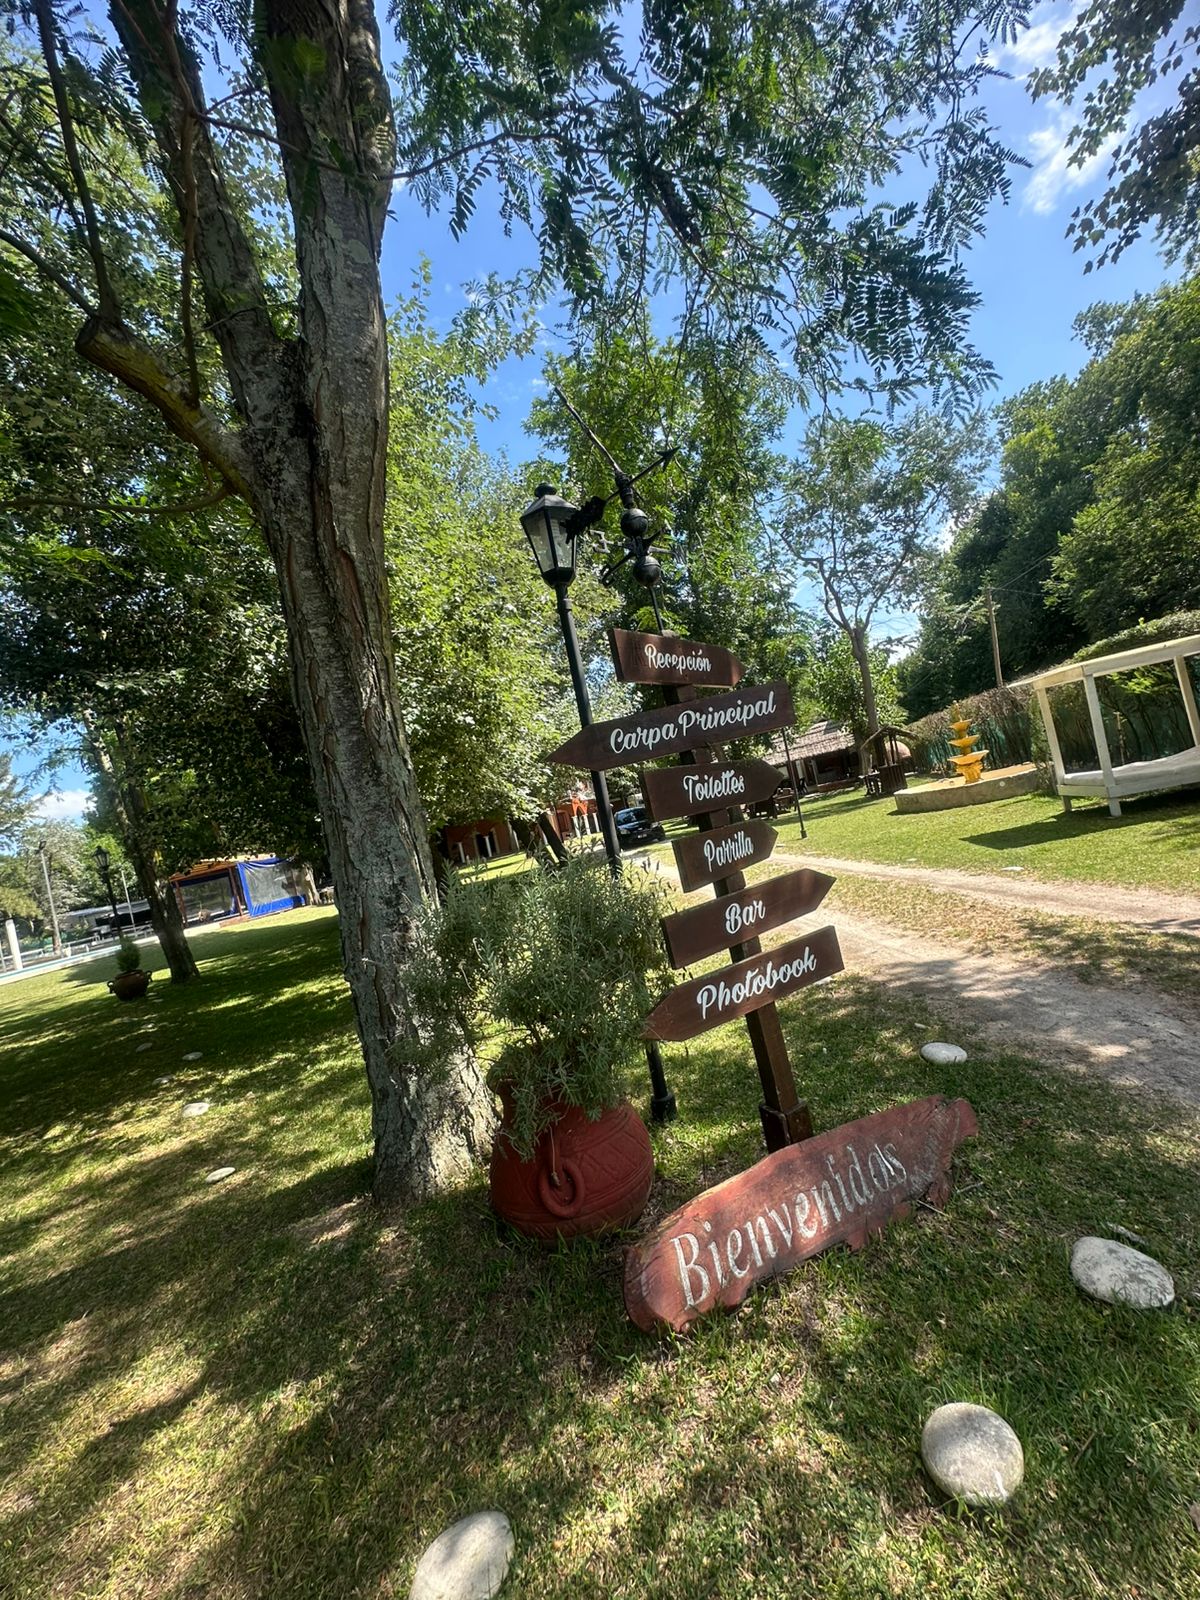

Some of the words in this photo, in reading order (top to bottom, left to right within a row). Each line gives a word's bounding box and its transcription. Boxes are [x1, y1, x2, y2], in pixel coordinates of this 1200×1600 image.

[644, 643, 711, 673] Recepción
[610, 722, 678, 754] Carpa
[678, 691, 776, 736] Principal
[683, 769, 745, 803] Toilettes
[704, 830, 754, 872] Parrilla
[725, 900, 766, 934] Bar
[696, 946, 817, 1019] Photobook
[669, 1142, 908, 1311] Bienvenidos
